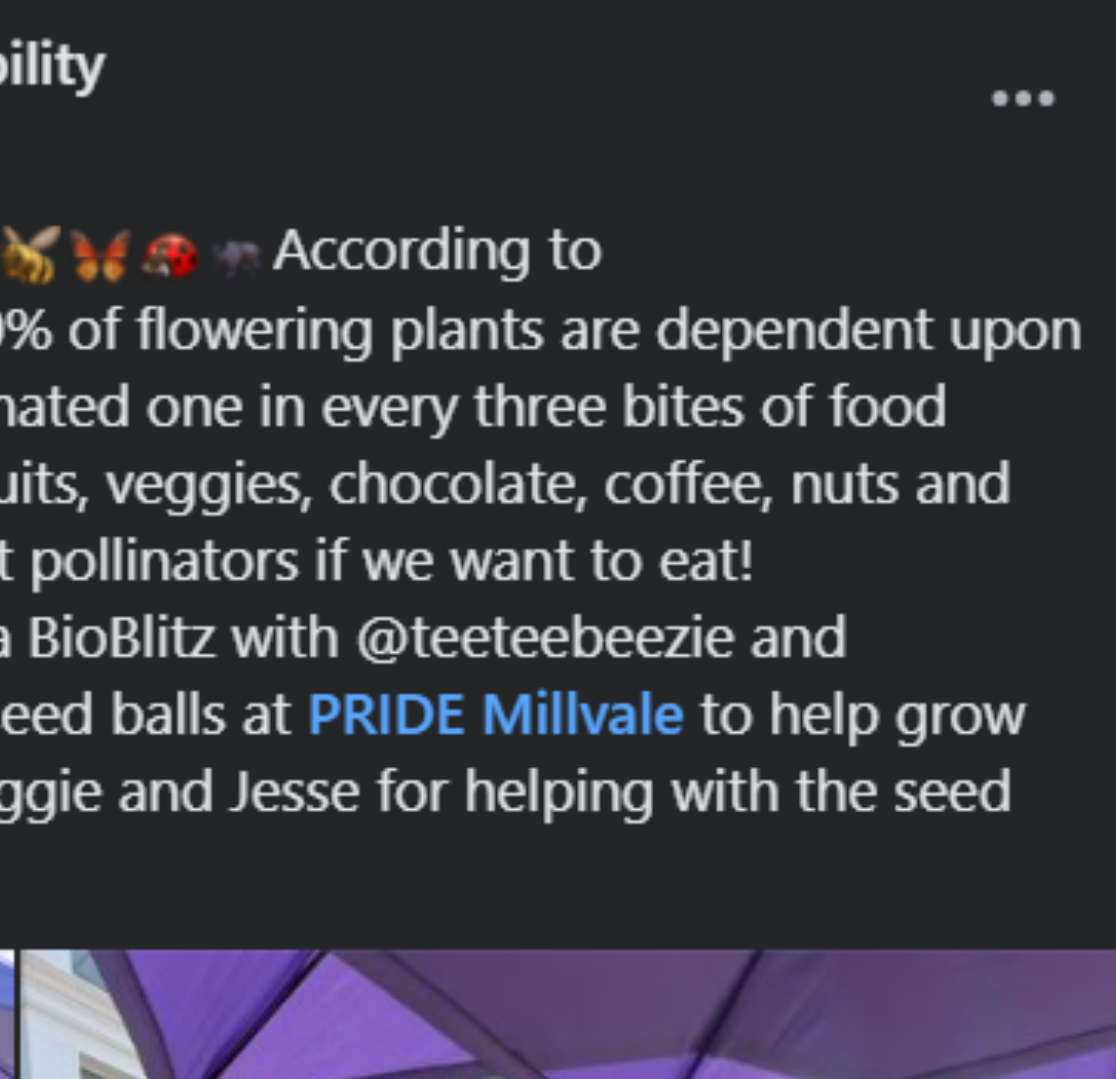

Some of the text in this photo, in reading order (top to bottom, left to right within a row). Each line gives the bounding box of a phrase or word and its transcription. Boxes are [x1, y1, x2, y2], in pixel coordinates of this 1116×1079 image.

[272, 225, 530, 282] According
[547, 228, 603, 270] to
[69, 305, 124, 350] of
[135, 305, 372, 362] flowering
[392, 305, 545, 362] plants
[560, 317, 640, 350] are
[656, 305, 935, 362] dependent
[951, 317, 1081, 362] upon
[146, 394, 243, 427] one
[261, 382, 305, 427] in
[322, 394, 461, 439] every
[473, 382, 607, 427] three
[624, 382, 745, 427] bites
[761, 382, 816, 427] of
[828, 382, 946, 427] food
[105, 459, 312, 516] veggies,
[329, 459, 588, 513] chocolate,
[605, 459, 773, 513] coffee,
[793, 462, 899, 504] nuts
[916, 459, 1010, 504] and
[32, 536, 300, 593] pollinators
[316, 536, 351, 581] if
[362, 548, 434, 581] we
[448, 539, 576, 581] want
[590, 539, 643, 581] to
[659, 539, 751, 581] eat!
[30, 613, 217, 658] BioBlitz
[230, 613, 338, 658] with
[357, 613, 736, 664] @teeteebeezie
[750, 613, 846, 658] and
[112, 690, 227, 735] balls
[242, 693, 292, 735] at
[310, 693, 465, 735] PRIDE
[484, 688, 684, 735] Millvale
[699, 693, 754, 735] to
[771, 690, 880, 747] help
[895, 702, 1028, 747] grow
[118, 767, 212, 812] and
[228, 770, 360, 812] Jesse
[375, 767, 451, 812] for
[466, 767, 653, 824] helping
[670, 767, 779, 812] with
[794, 767, 878, 812] the
[895, 767, 1010, 812] seed
